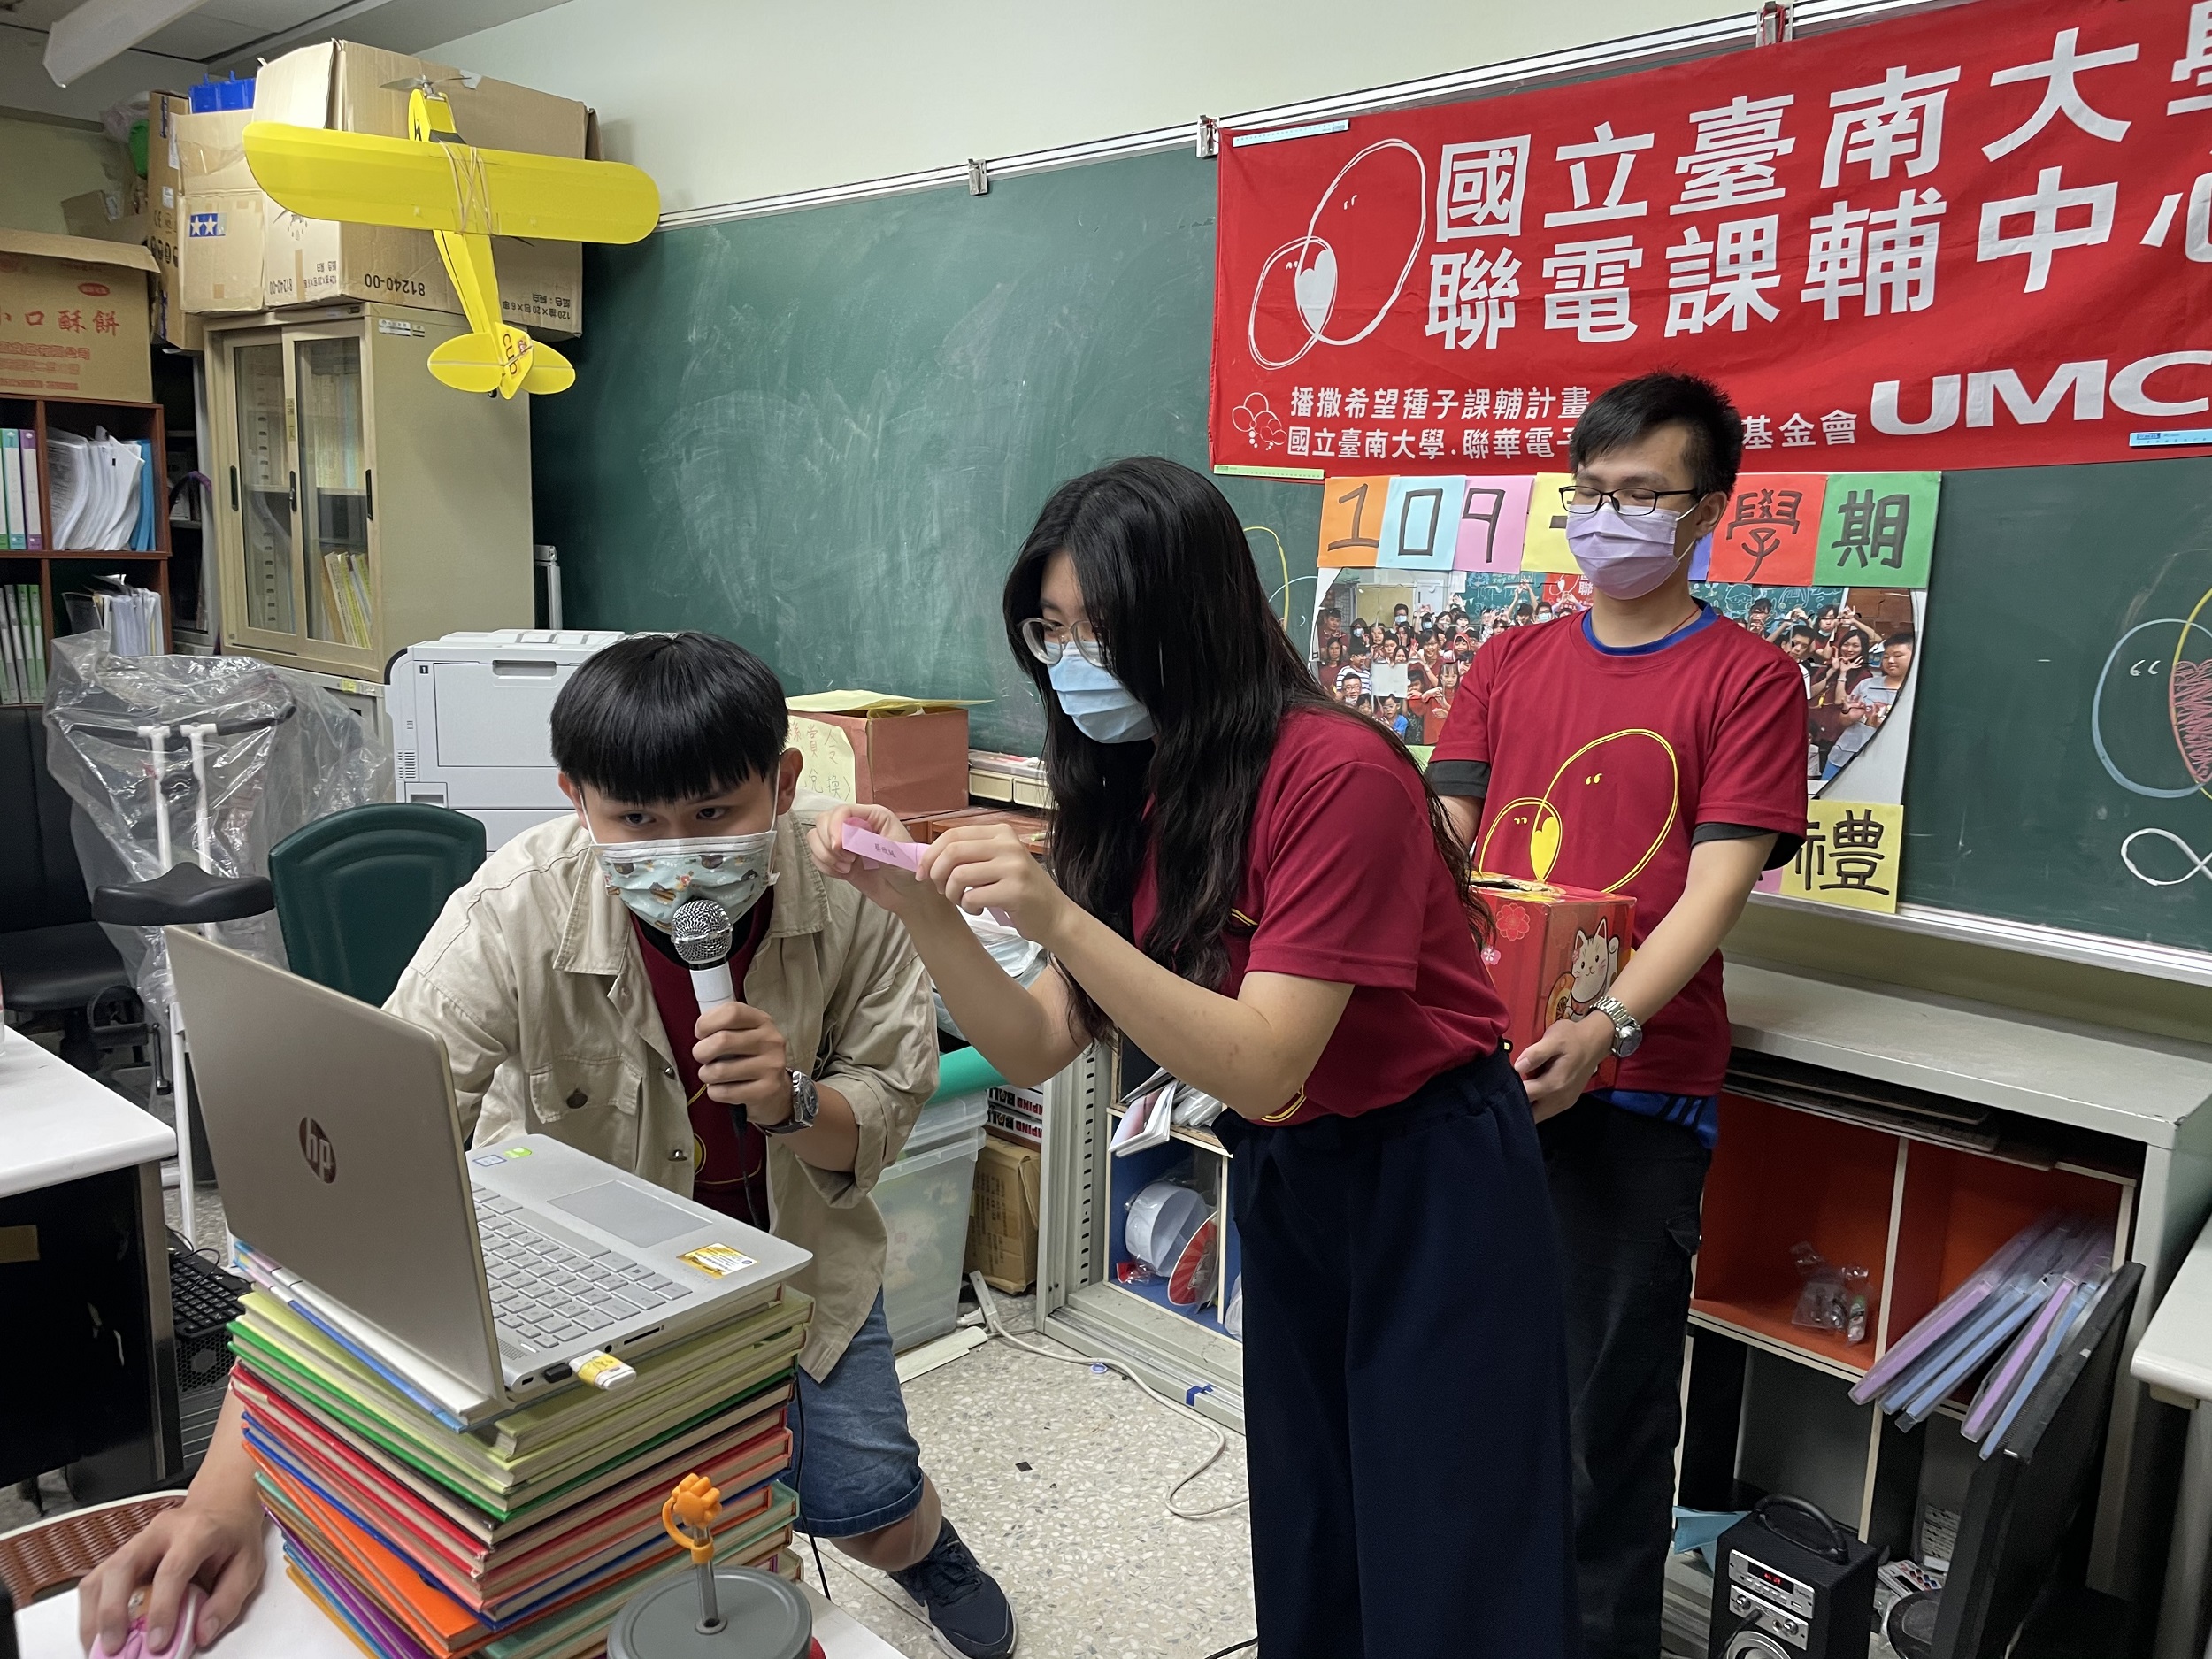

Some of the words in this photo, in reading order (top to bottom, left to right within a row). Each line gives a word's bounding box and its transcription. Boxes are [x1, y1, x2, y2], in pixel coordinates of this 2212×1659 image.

[364, 273, 426, 296] 81240-00
[1291, 386, 1592, 421] 播撒希望種子課輔計畫
[1870, 350, 2212, 436] UMC
[1740, 408, 1858, 450] 基金會
[1726, 488, 1910, 582] 學期
[1794, 809, 1890, 896] 禮
[304, 1116, 332, 1183] hp
